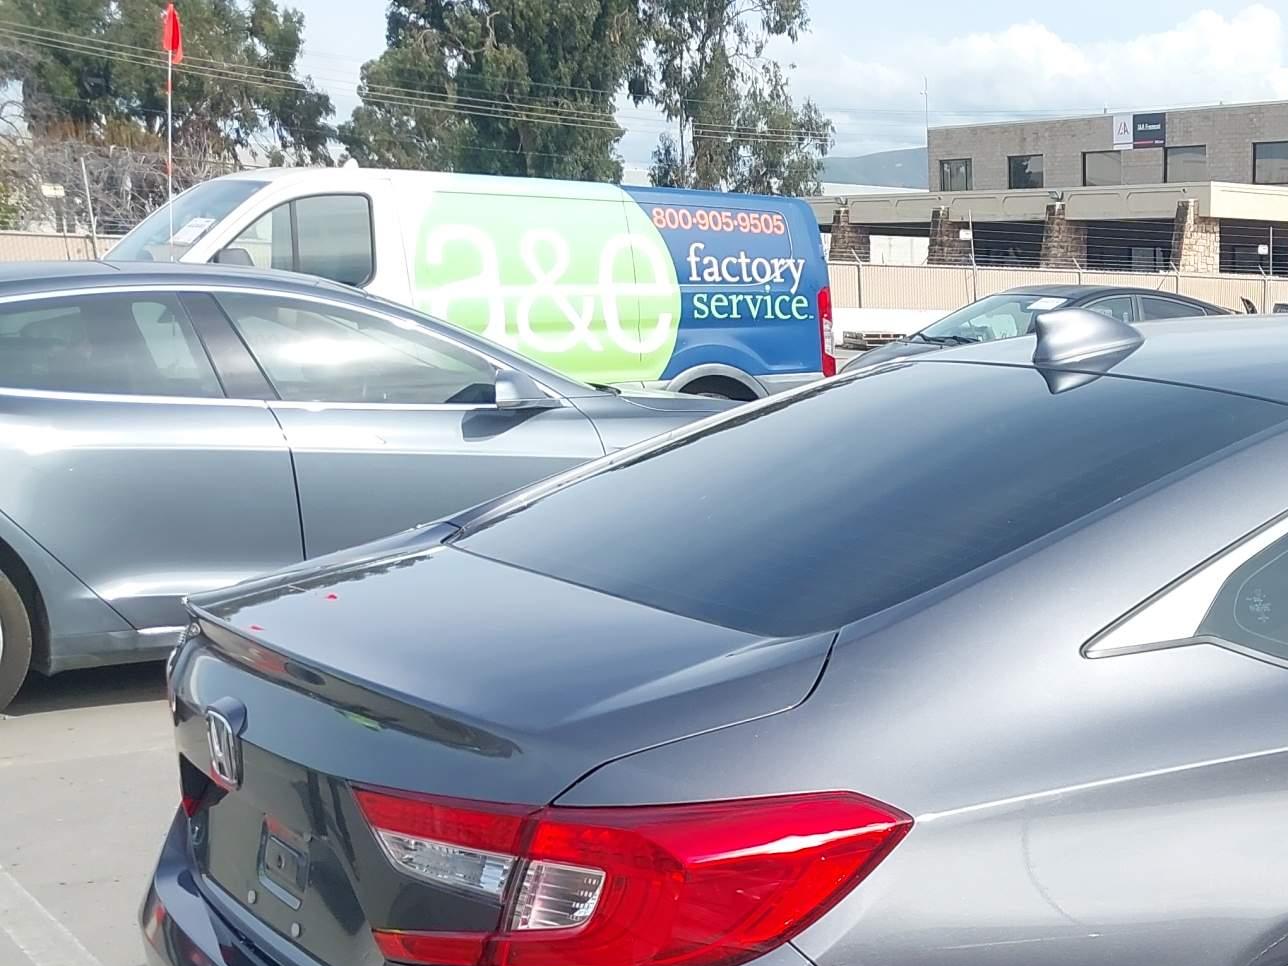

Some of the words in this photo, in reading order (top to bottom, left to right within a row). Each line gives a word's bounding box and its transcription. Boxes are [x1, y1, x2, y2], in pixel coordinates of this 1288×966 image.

[425, 223, 674, 354] a&e
[687, 242, 805, 294] factory
[693, 284, 810, 320] service
